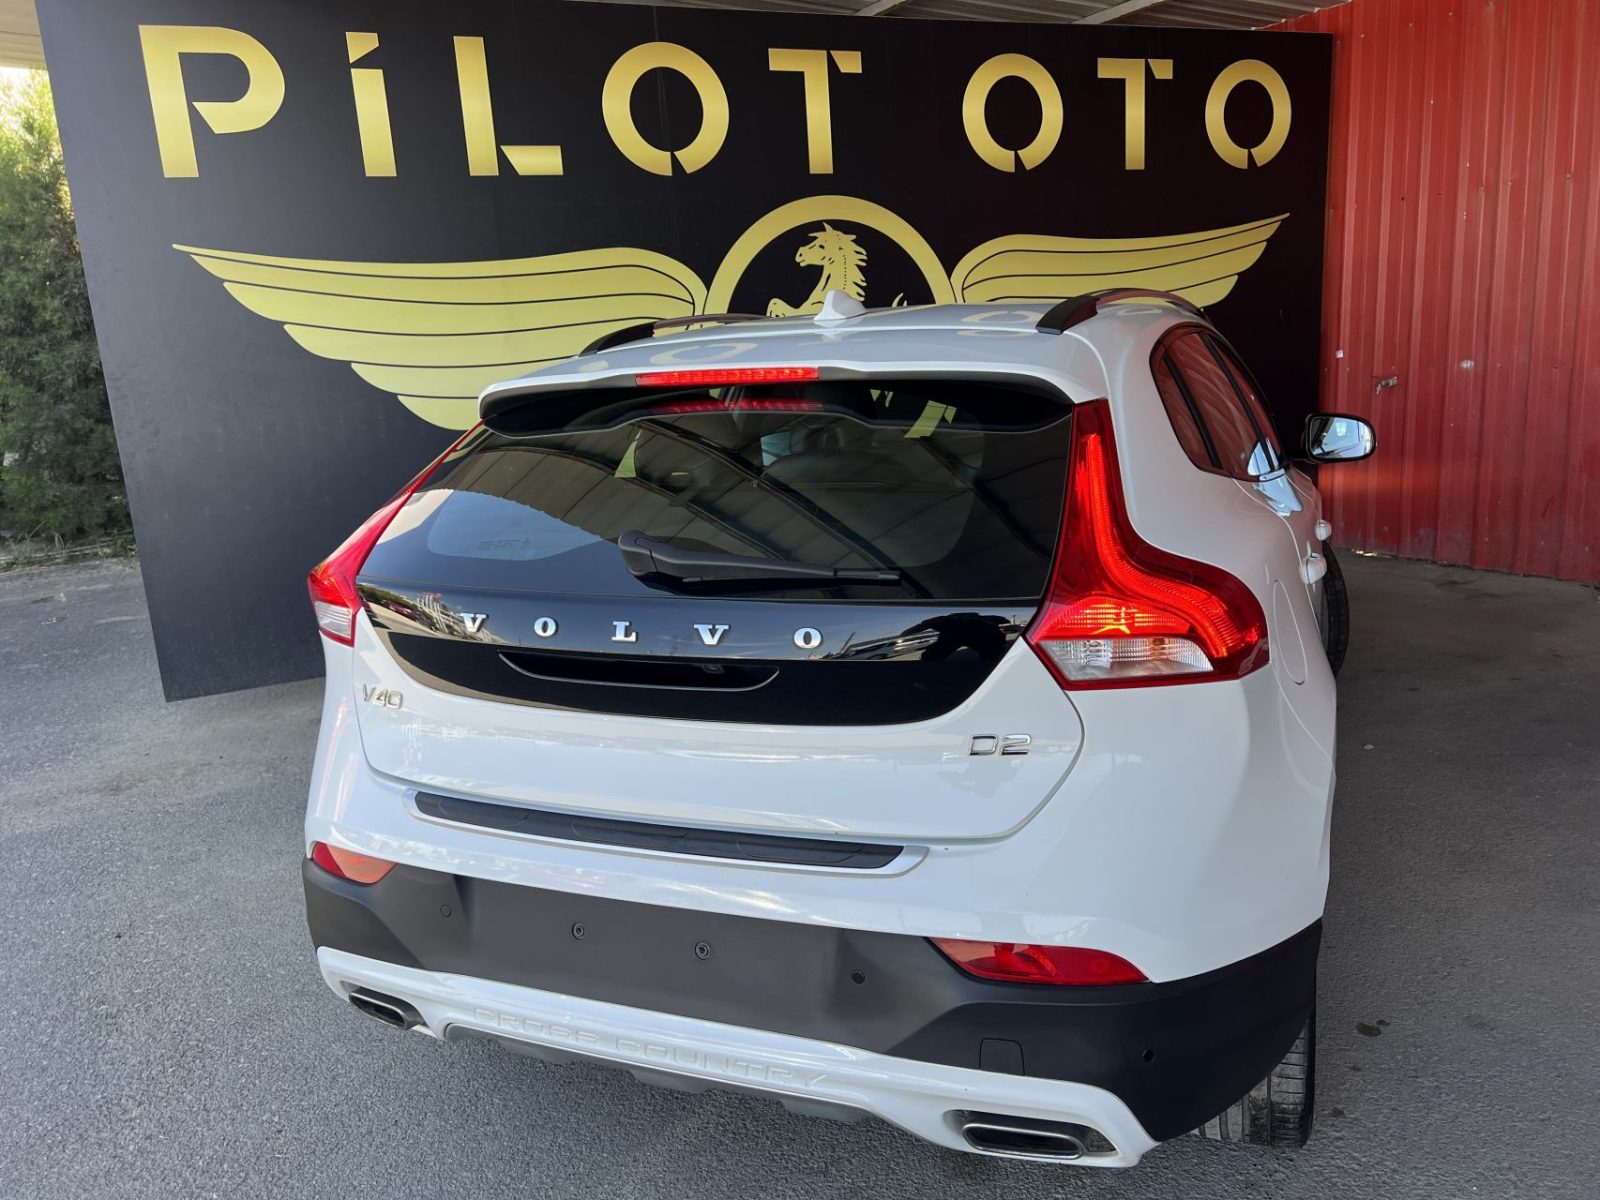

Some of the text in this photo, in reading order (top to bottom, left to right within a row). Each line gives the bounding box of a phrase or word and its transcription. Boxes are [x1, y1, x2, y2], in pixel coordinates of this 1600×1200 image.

[962, 52, 1292, 172] OTO
[461, 612, 822, 649] VOLVO
[362, 683, 403, 710] V40
[968, 733, 1032, 756] D2
[473, 1006, 827, 1089] CROSS COUNTRY
